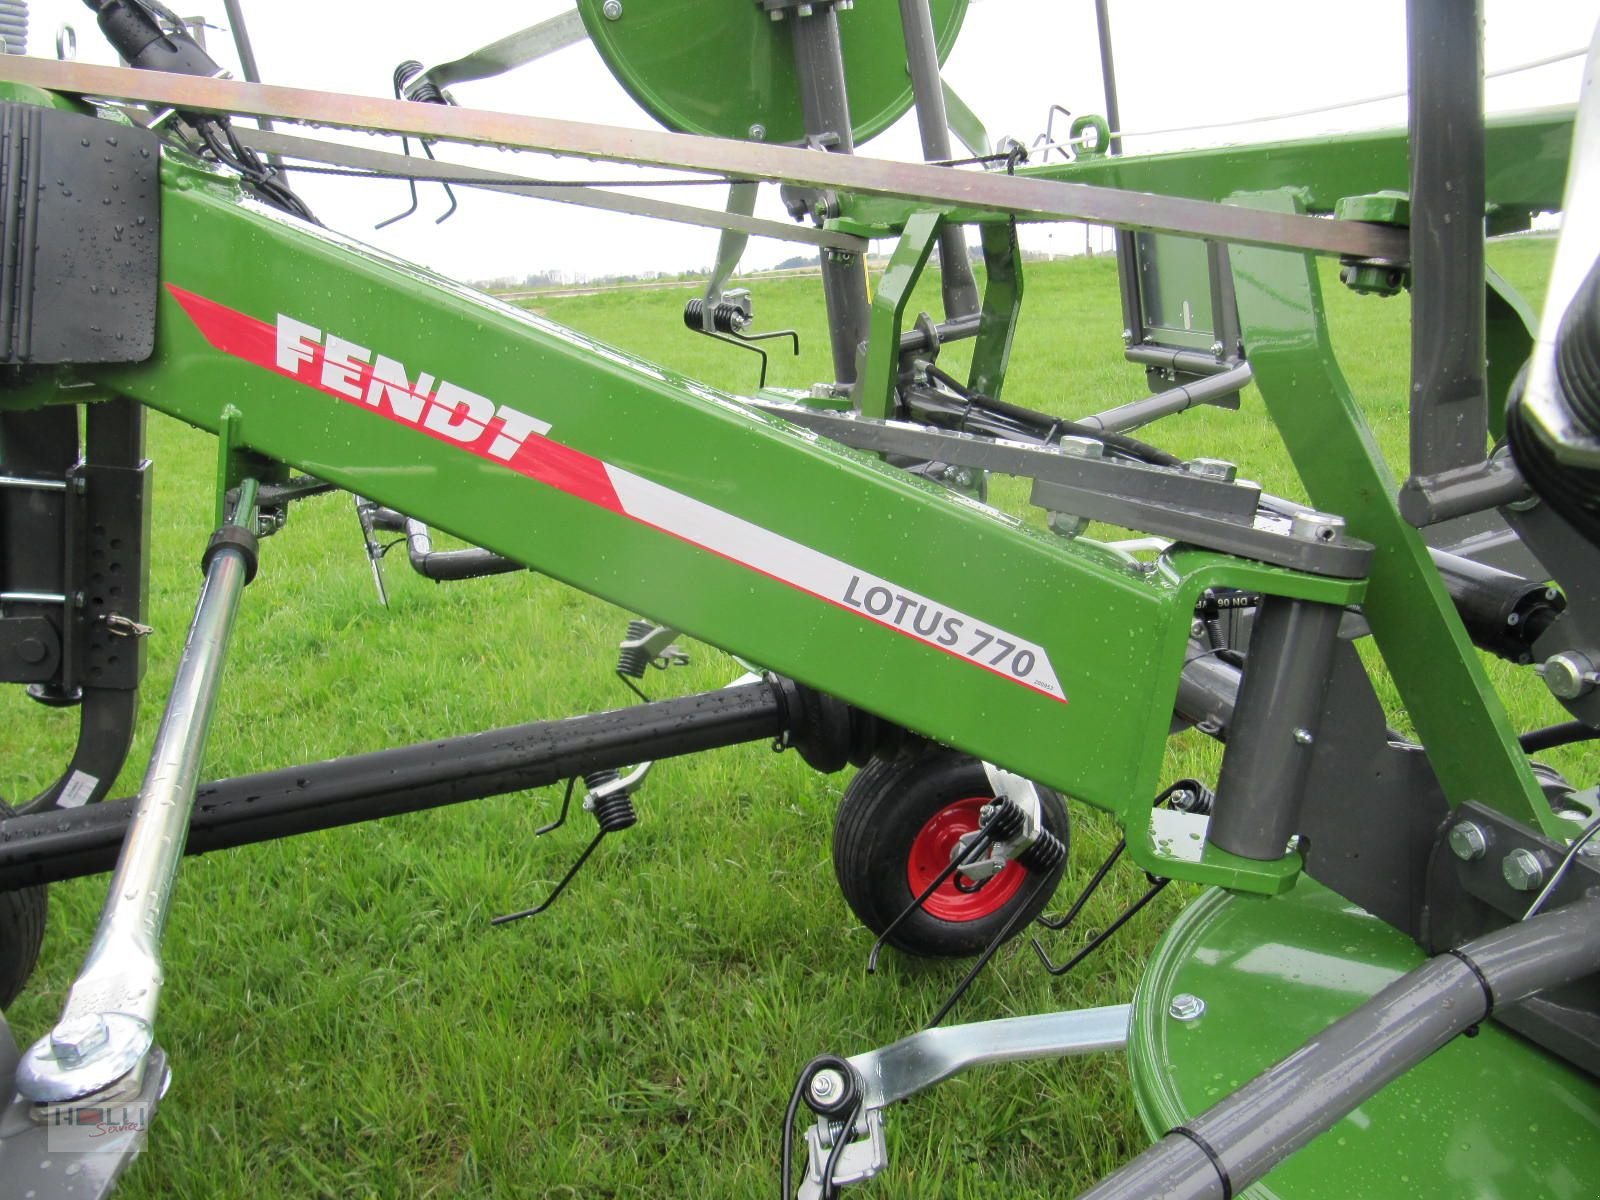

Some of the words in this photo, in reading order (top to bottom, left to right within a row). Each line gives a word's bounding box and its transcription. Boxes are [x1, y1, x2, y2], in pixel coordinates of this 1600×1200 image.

[276, 312, 553, 462] FENDT
[842, 575, 965, 647] LOTUS
[966, 628, 1037, 678] 770
